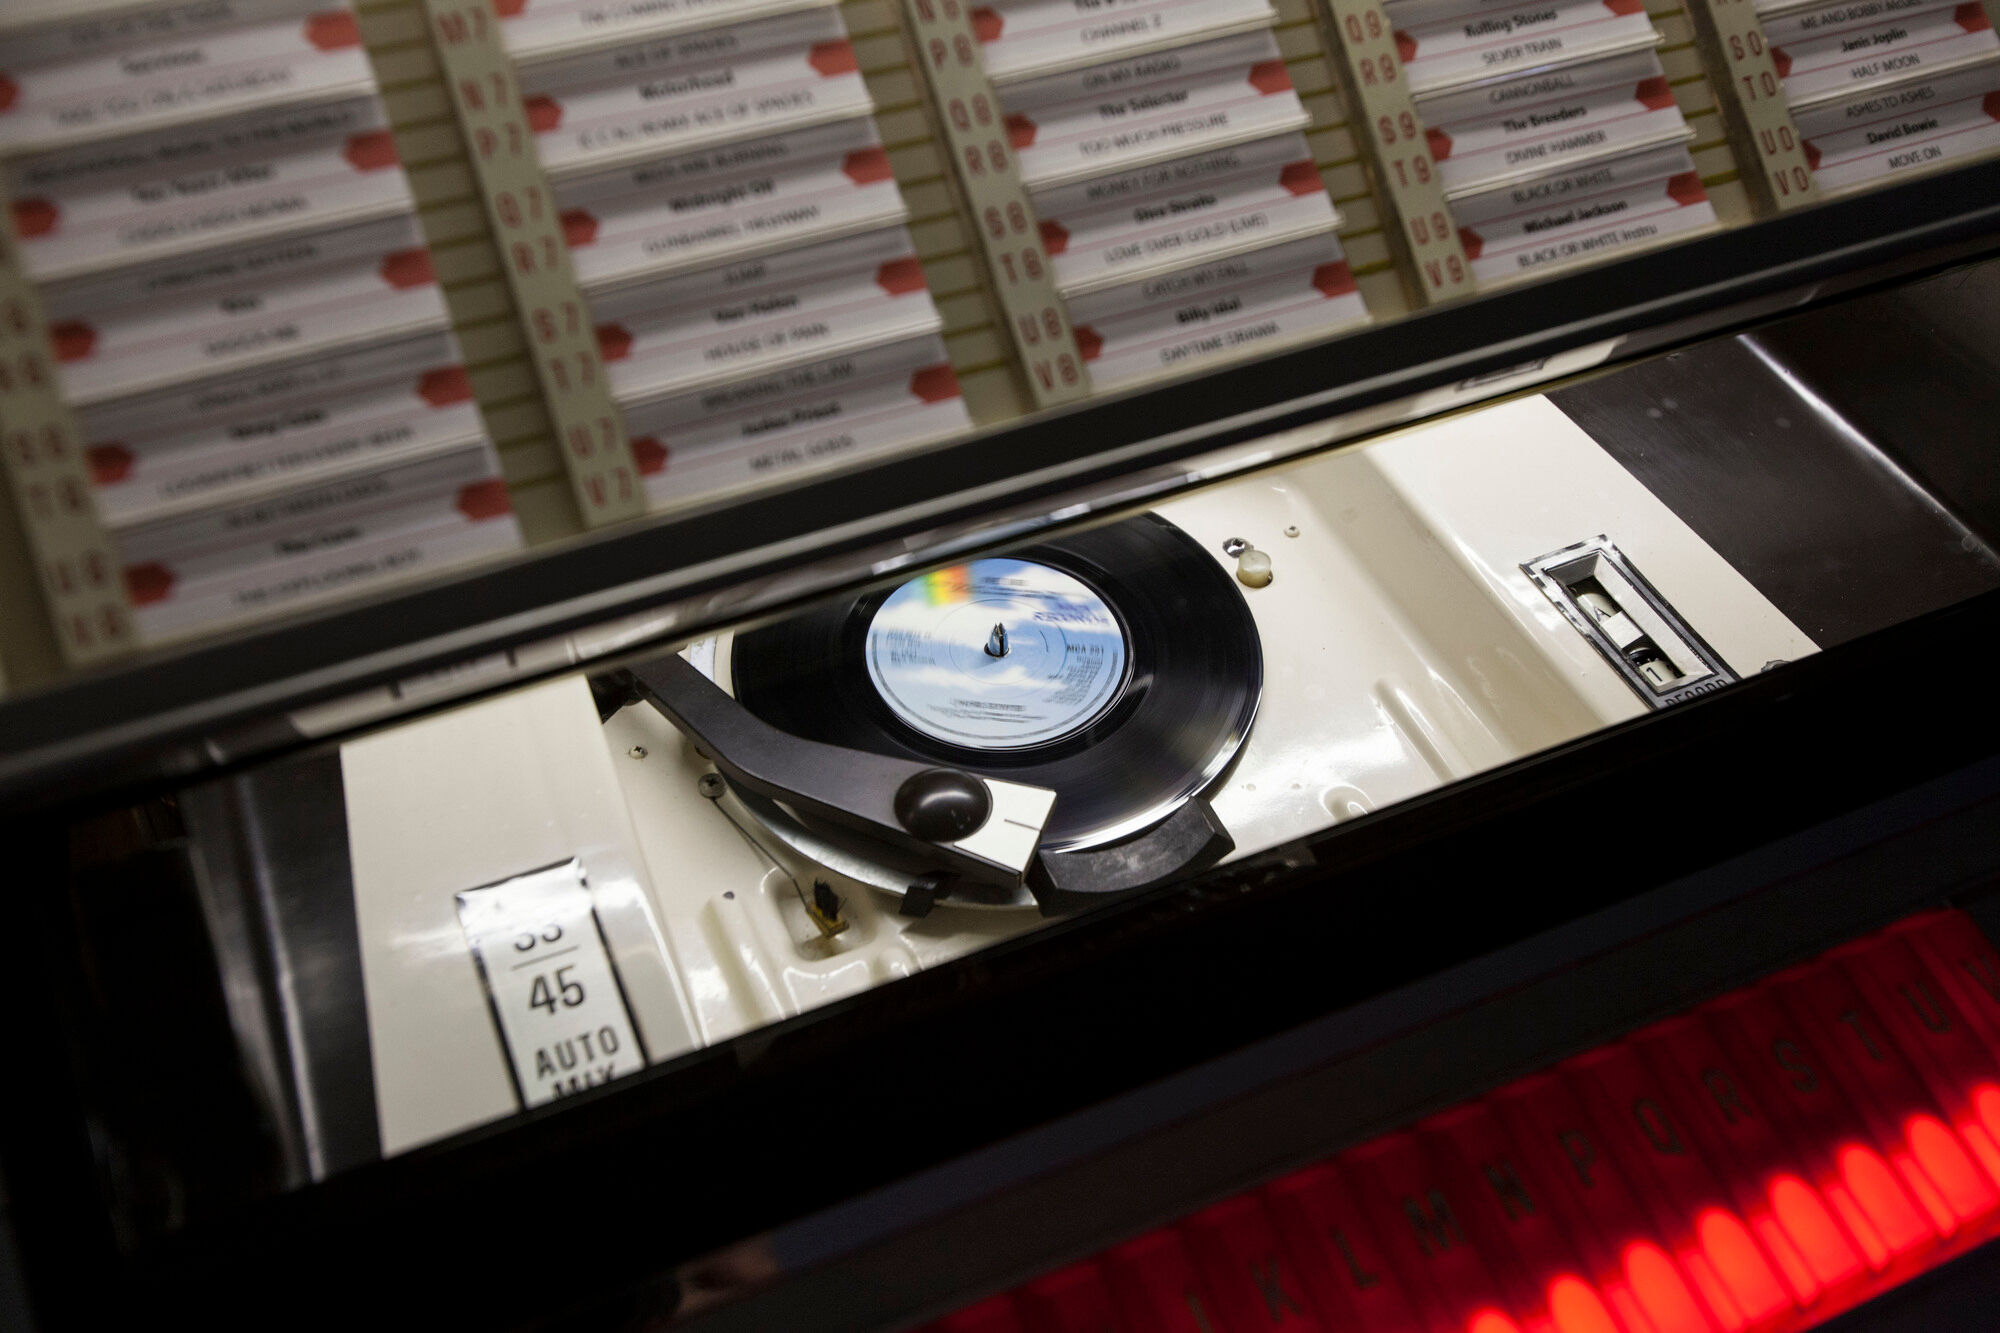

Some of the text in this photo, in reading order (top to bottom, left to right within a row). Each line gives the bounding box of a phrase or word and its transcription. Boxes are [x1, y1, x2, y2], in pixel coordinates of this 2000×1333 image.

[1464, 6, 1558, 41] Rolling Stones
[1801, 16, 1818, 30] ME
[1820, 9, 1847, 25] AND
[1847, 1, 1883, 19] BOBBY
[1481, 36, 1562, 66] SILVER TRAIN
[1840, 26, 1909, 53] Janis Joplin
[1852, 53, 1921, 79] HALF MOON
[1488, 74, 1576, 106] CANNONBALL
[1846, 86, 1936, 118] ASHES TO ASHES
[1503, 103, 1587, 134] The Breeders
[1867, 116, 1939, 144] David Bowie
[1505, 129, 1608, 165] DIVINE HAMMER
[1888, 145, 1943, 169] MOVE ON
[1511, 168, 1615, 204] BLACK OR WHITE
[1523, 197, 1629, 234] Michael Jackson
[1517, 246, 1562, 269] BLACK
[1561, 240, 1584, 257] OR
[1583, 232, 1622, 252] WHITE
[528, 964, 587, 1017] 45
[535, 1025, 621, 1080] AUTO
